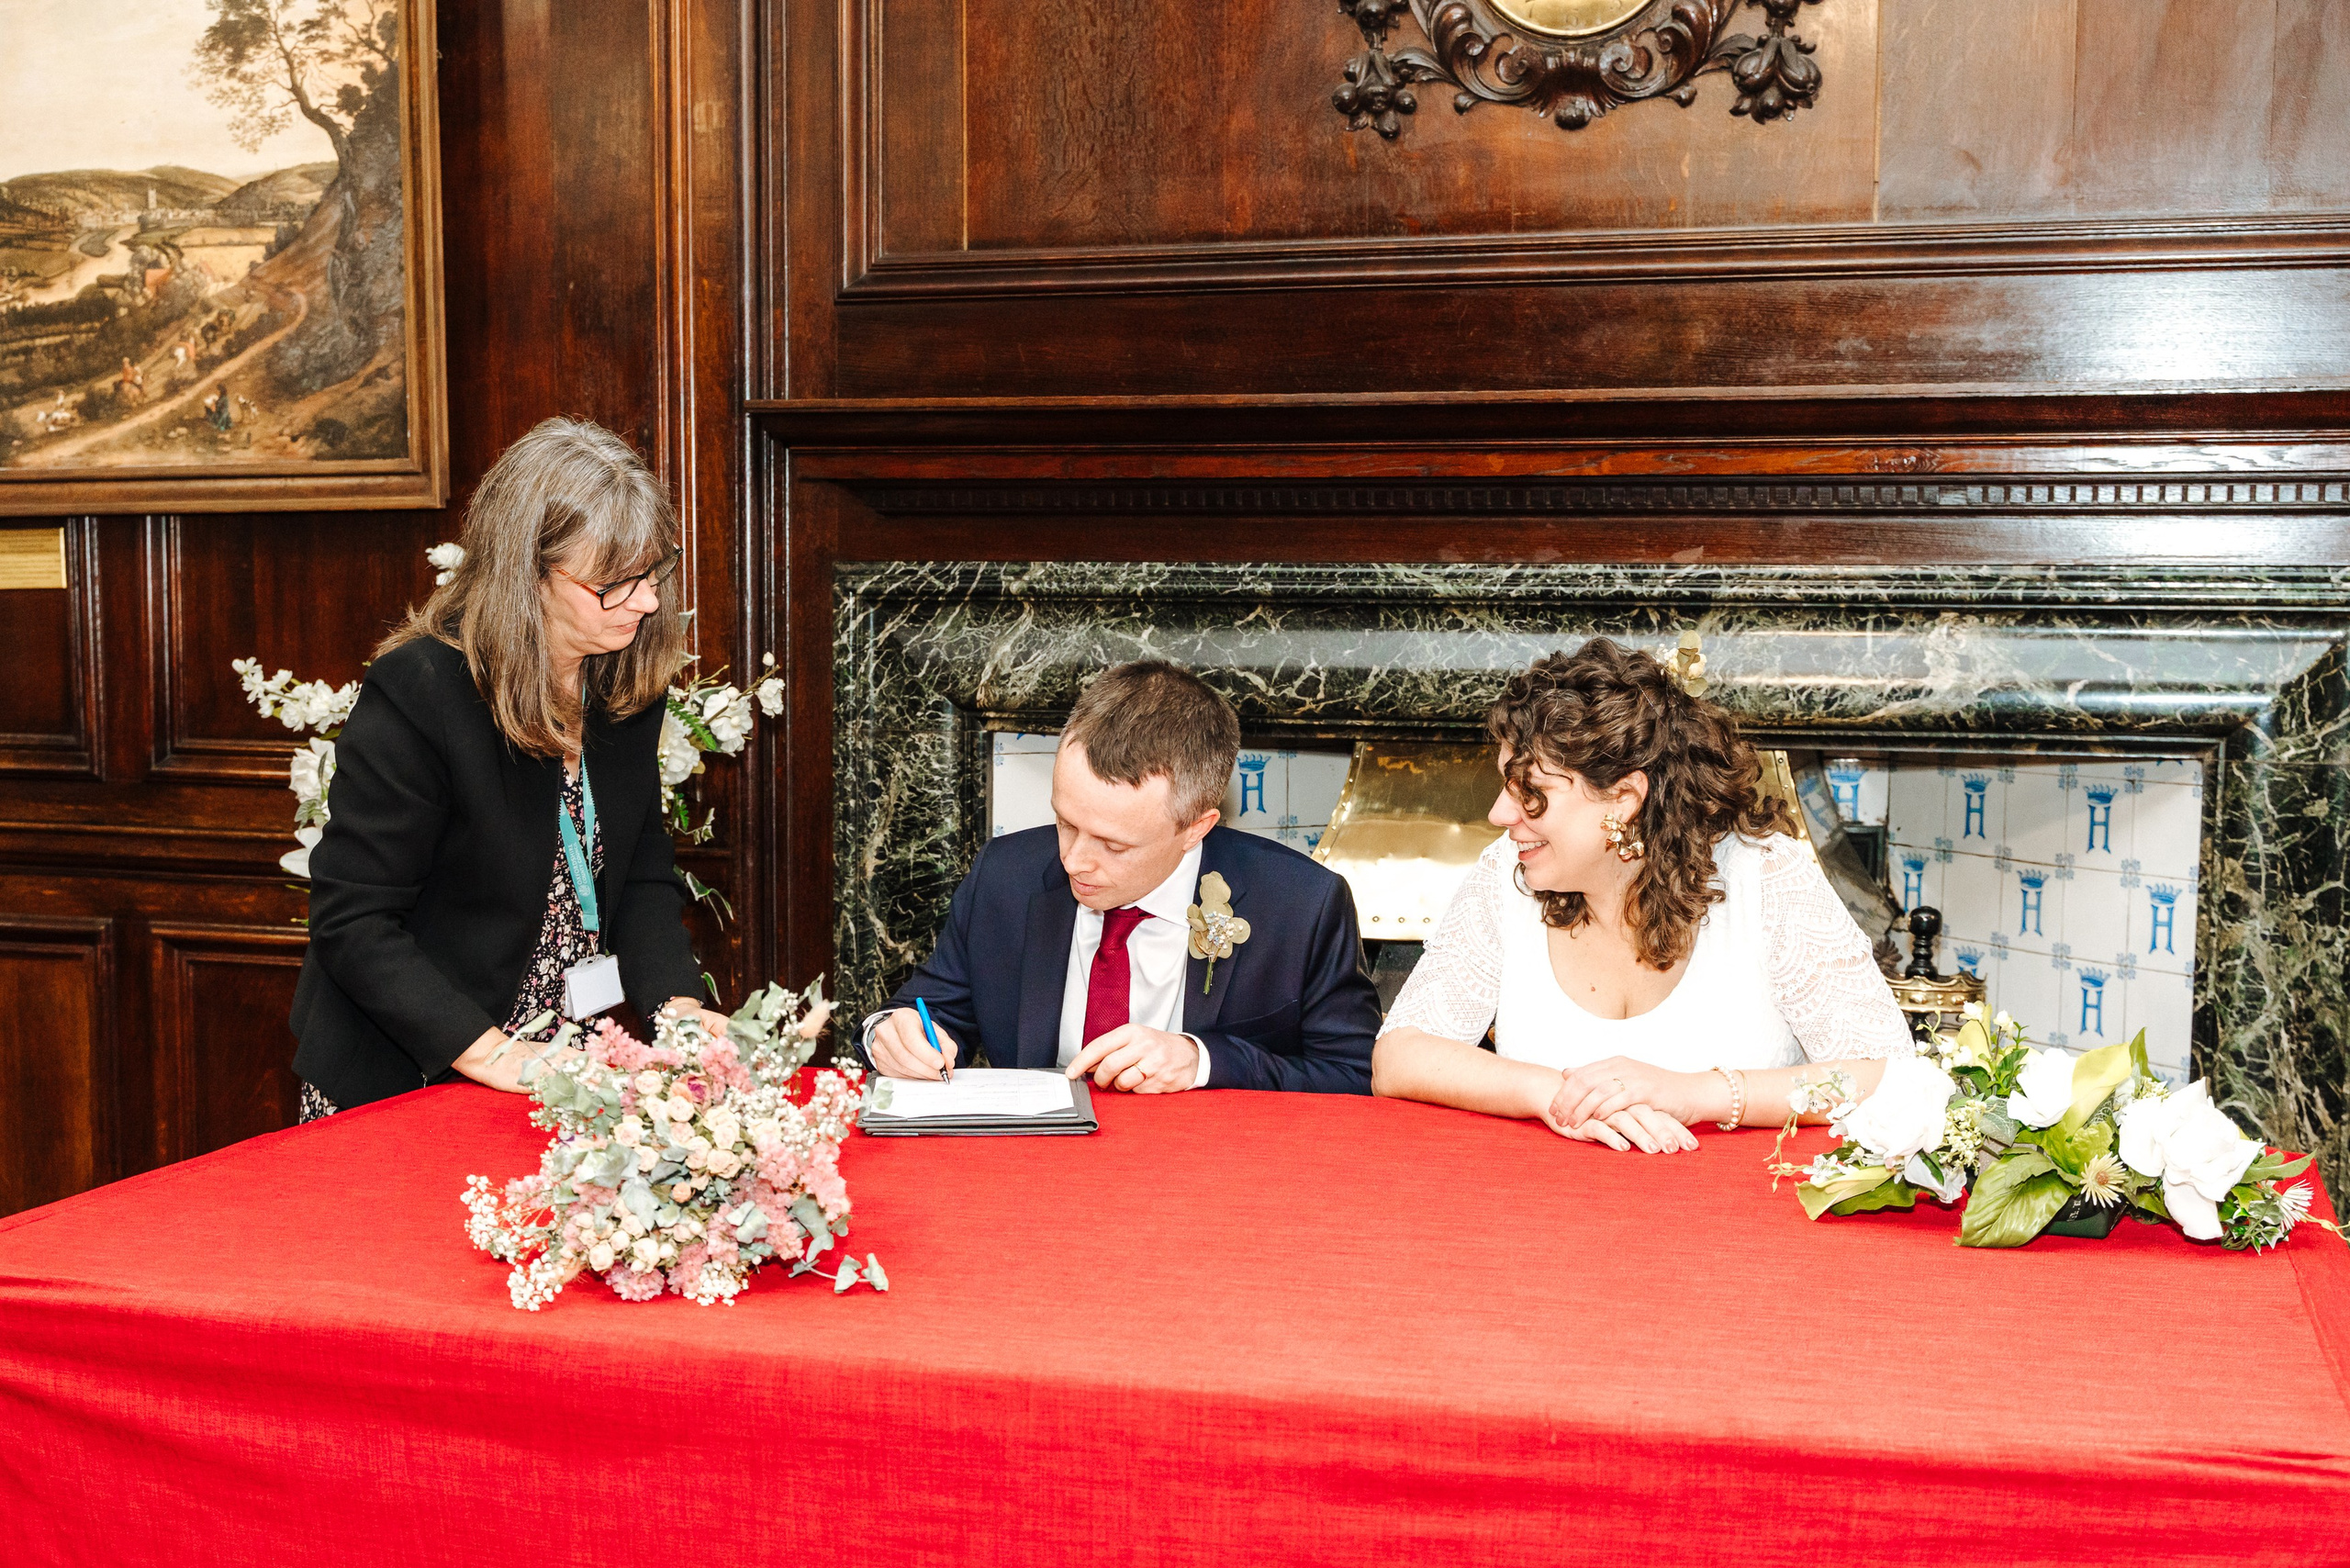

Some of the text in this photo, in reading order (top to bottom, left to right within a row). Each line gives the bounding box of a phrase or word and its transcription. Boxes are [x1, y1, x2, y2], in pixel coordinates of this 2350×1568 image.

[567, 844, 583, 885] OXFORDSHIRE
[573, 842, 588, 884] COUNTY COUNCIL
